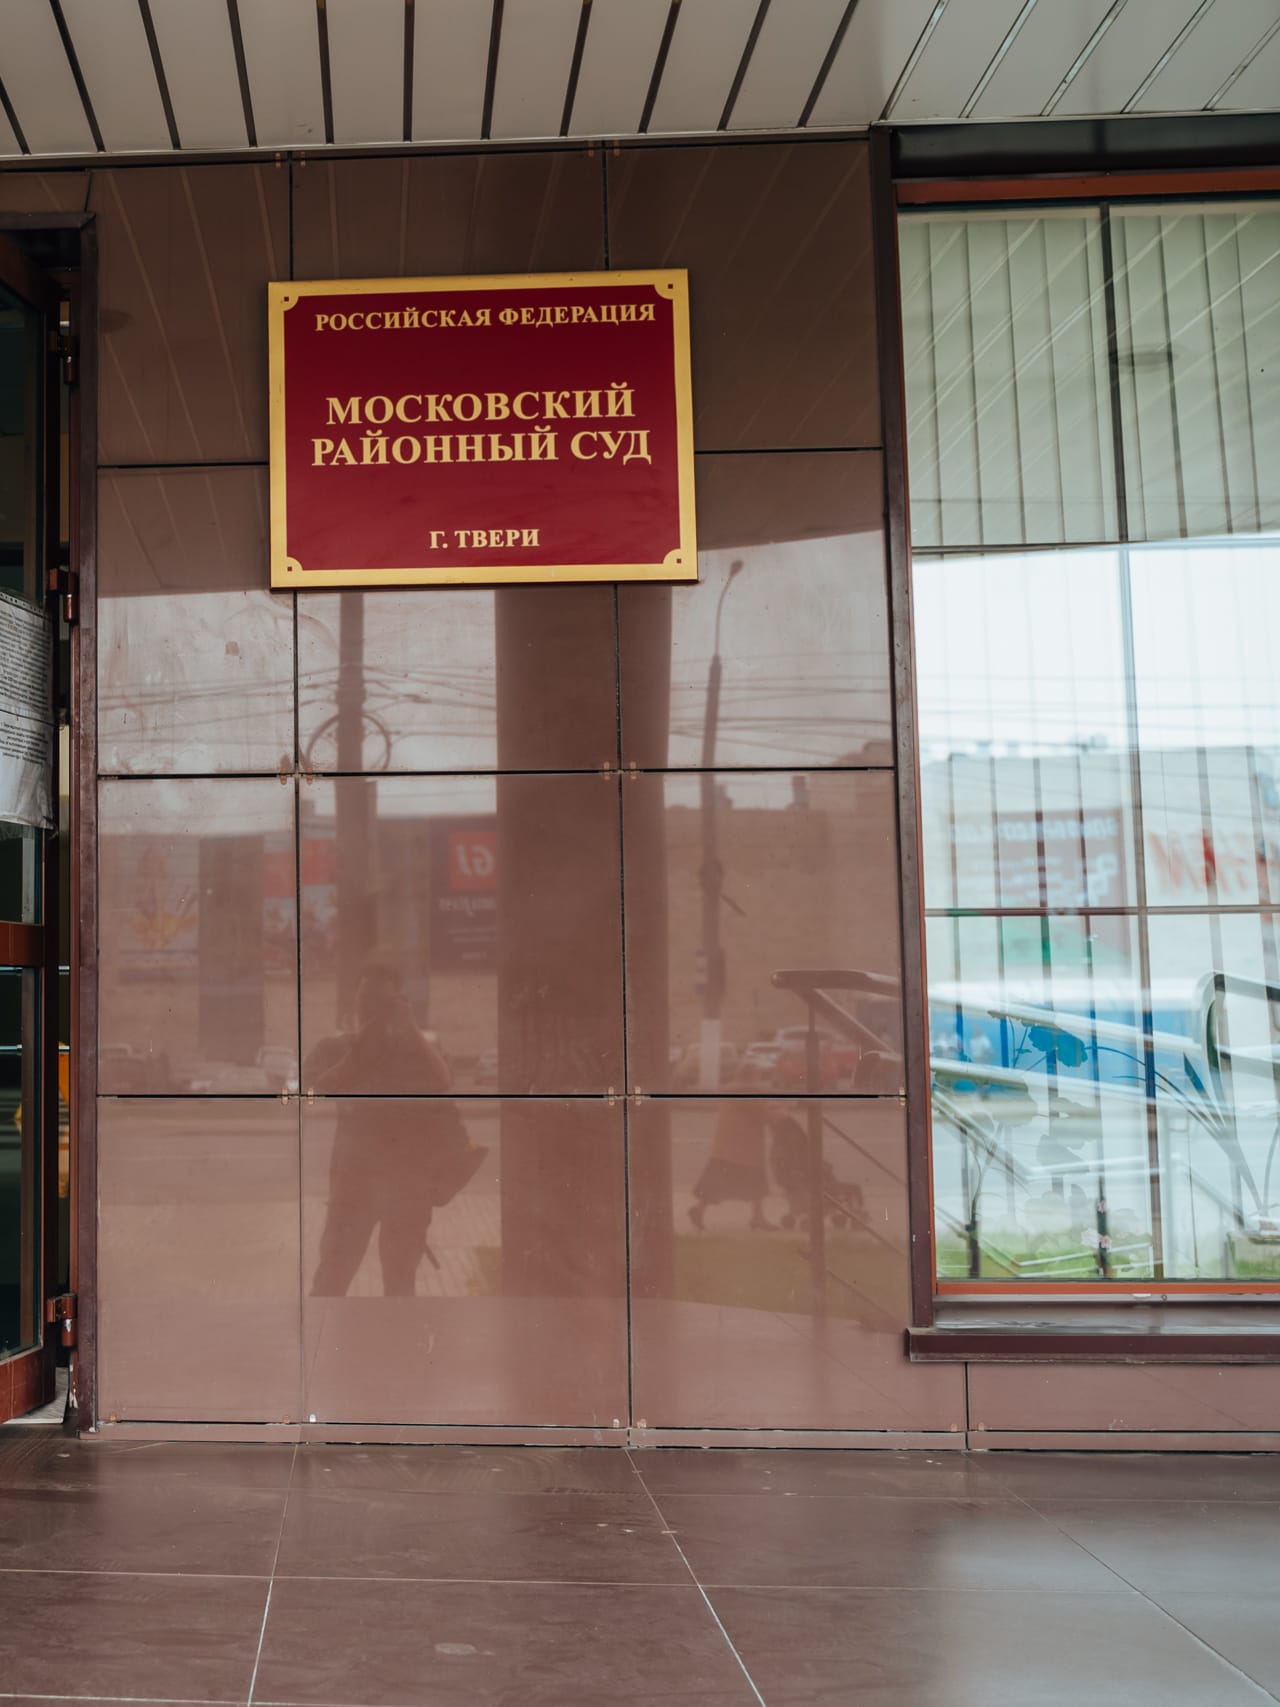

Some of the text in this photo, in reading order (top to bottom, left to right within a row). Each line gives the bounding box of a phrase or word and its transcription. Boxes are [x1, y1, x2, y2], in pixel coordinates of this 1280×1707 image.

[315, 303, 656, 331] РОССИЙСКАЯ ФЕДЕРАЦИЯ
[325, 382, 635, 425] МОСКОВСКИЙ
[311, 425, 652, 466] РАЙОННЫЙ СУД
[429, 528, 540, 549] Г. ТВЕРИ
